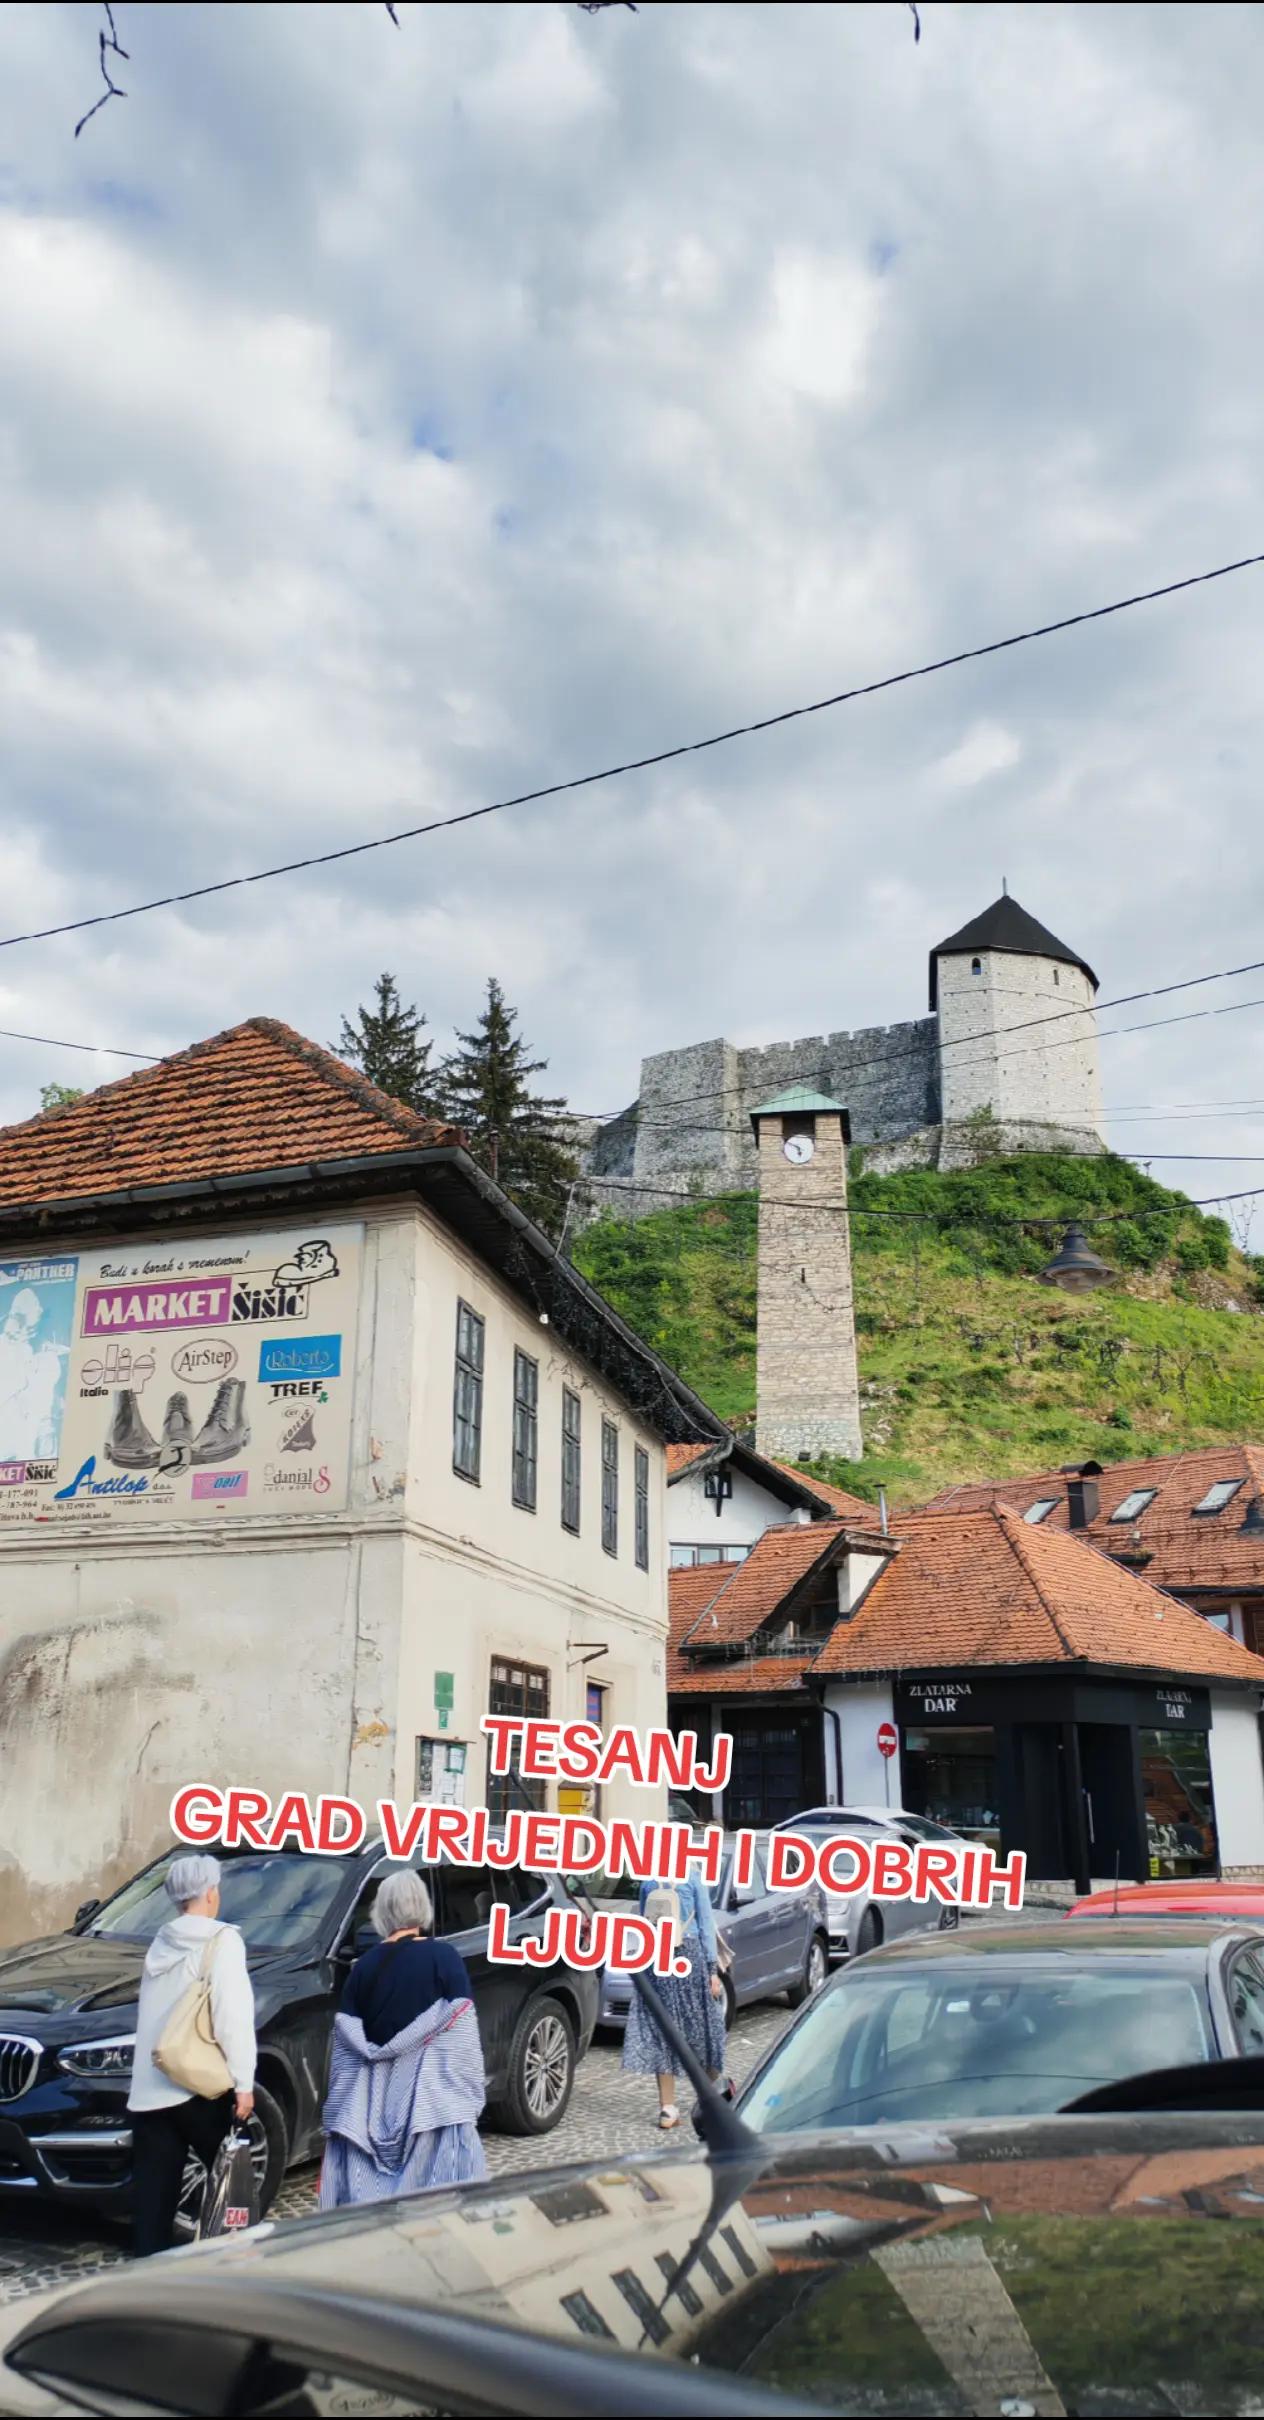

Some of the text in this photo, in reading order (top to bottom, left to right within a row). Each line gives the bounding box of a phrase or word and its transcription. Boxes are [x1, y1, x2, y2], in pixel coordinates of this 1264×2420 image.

[100, 1264, 126, 1279] Budi
[142, 1258, 175, 1275] korak
[177, 1262, 184, 1270] s
[188, 1250, 250, 1269] vremenom!
[93, 1288, 227, 1328] MARKET
[178, 1349, 232, 1372] AirStep
[270, 1380, 323, 1397] TREF
[54, 1455, 149, 1497] Antilop
[909, 1684, 973, 1696] ZLATARNA
[924, 1698, 957, 1713] DAR
